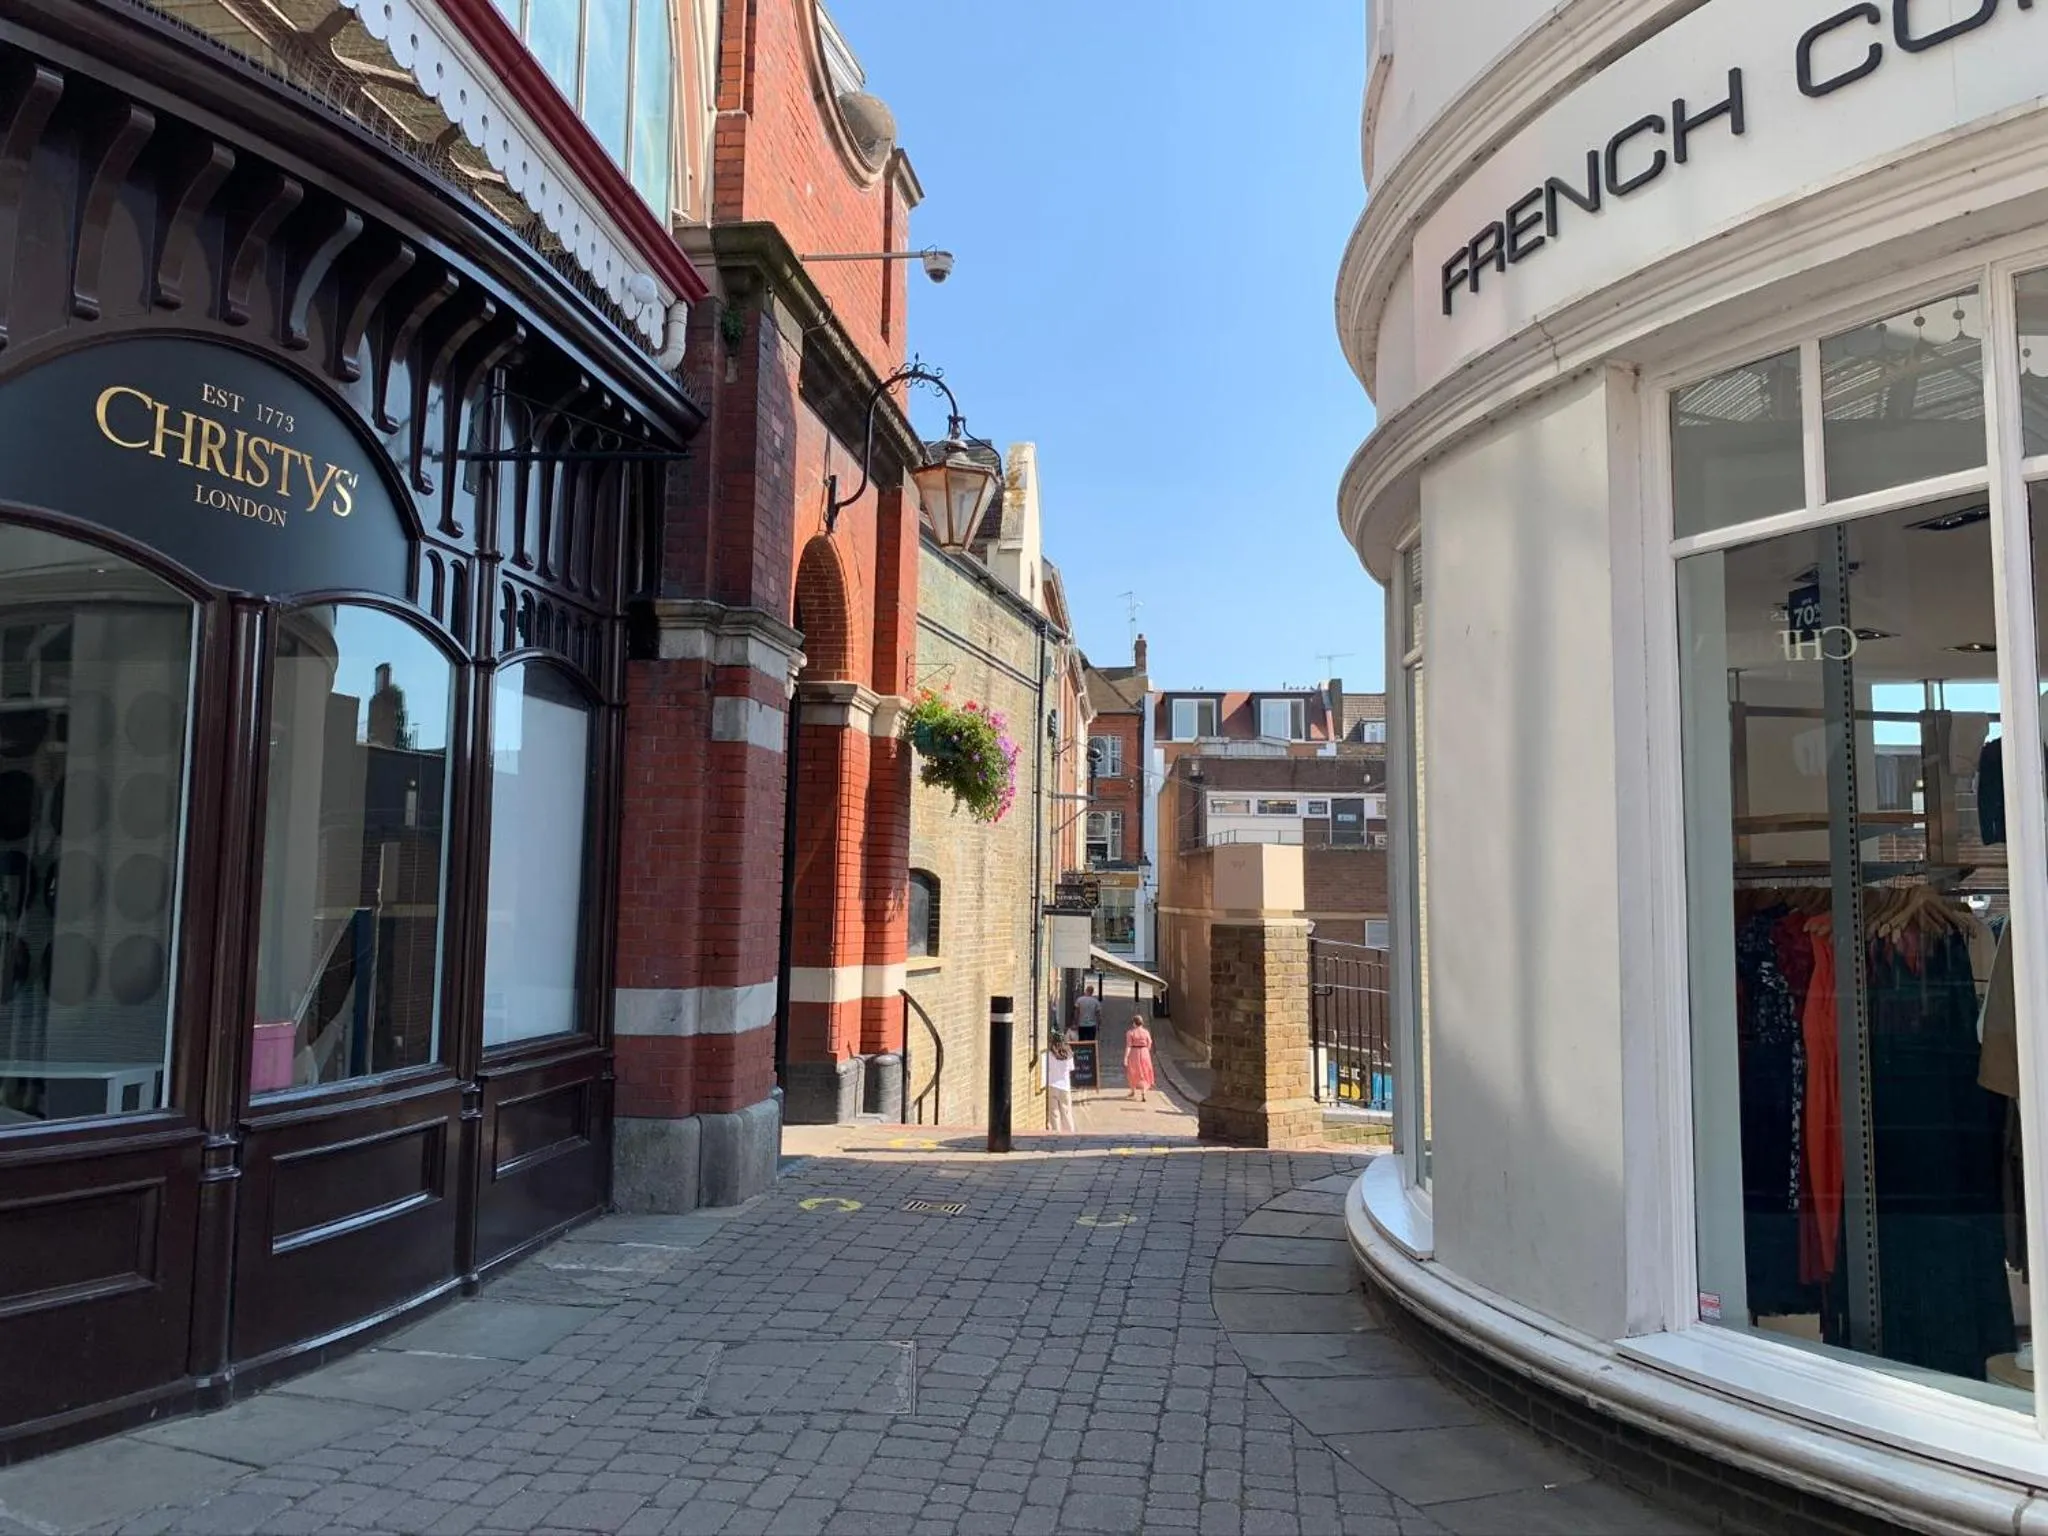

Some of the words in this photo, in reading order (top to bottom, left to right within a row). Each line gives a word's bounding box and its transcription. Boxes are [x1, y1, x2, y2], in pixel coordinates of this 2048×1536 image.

[1442, 66, 1746, 316] FRENCH
[202, 383, 245, 415] EST
[256, 403, 295, 434] 1773
[195, 485, 288, 528] LONDON
